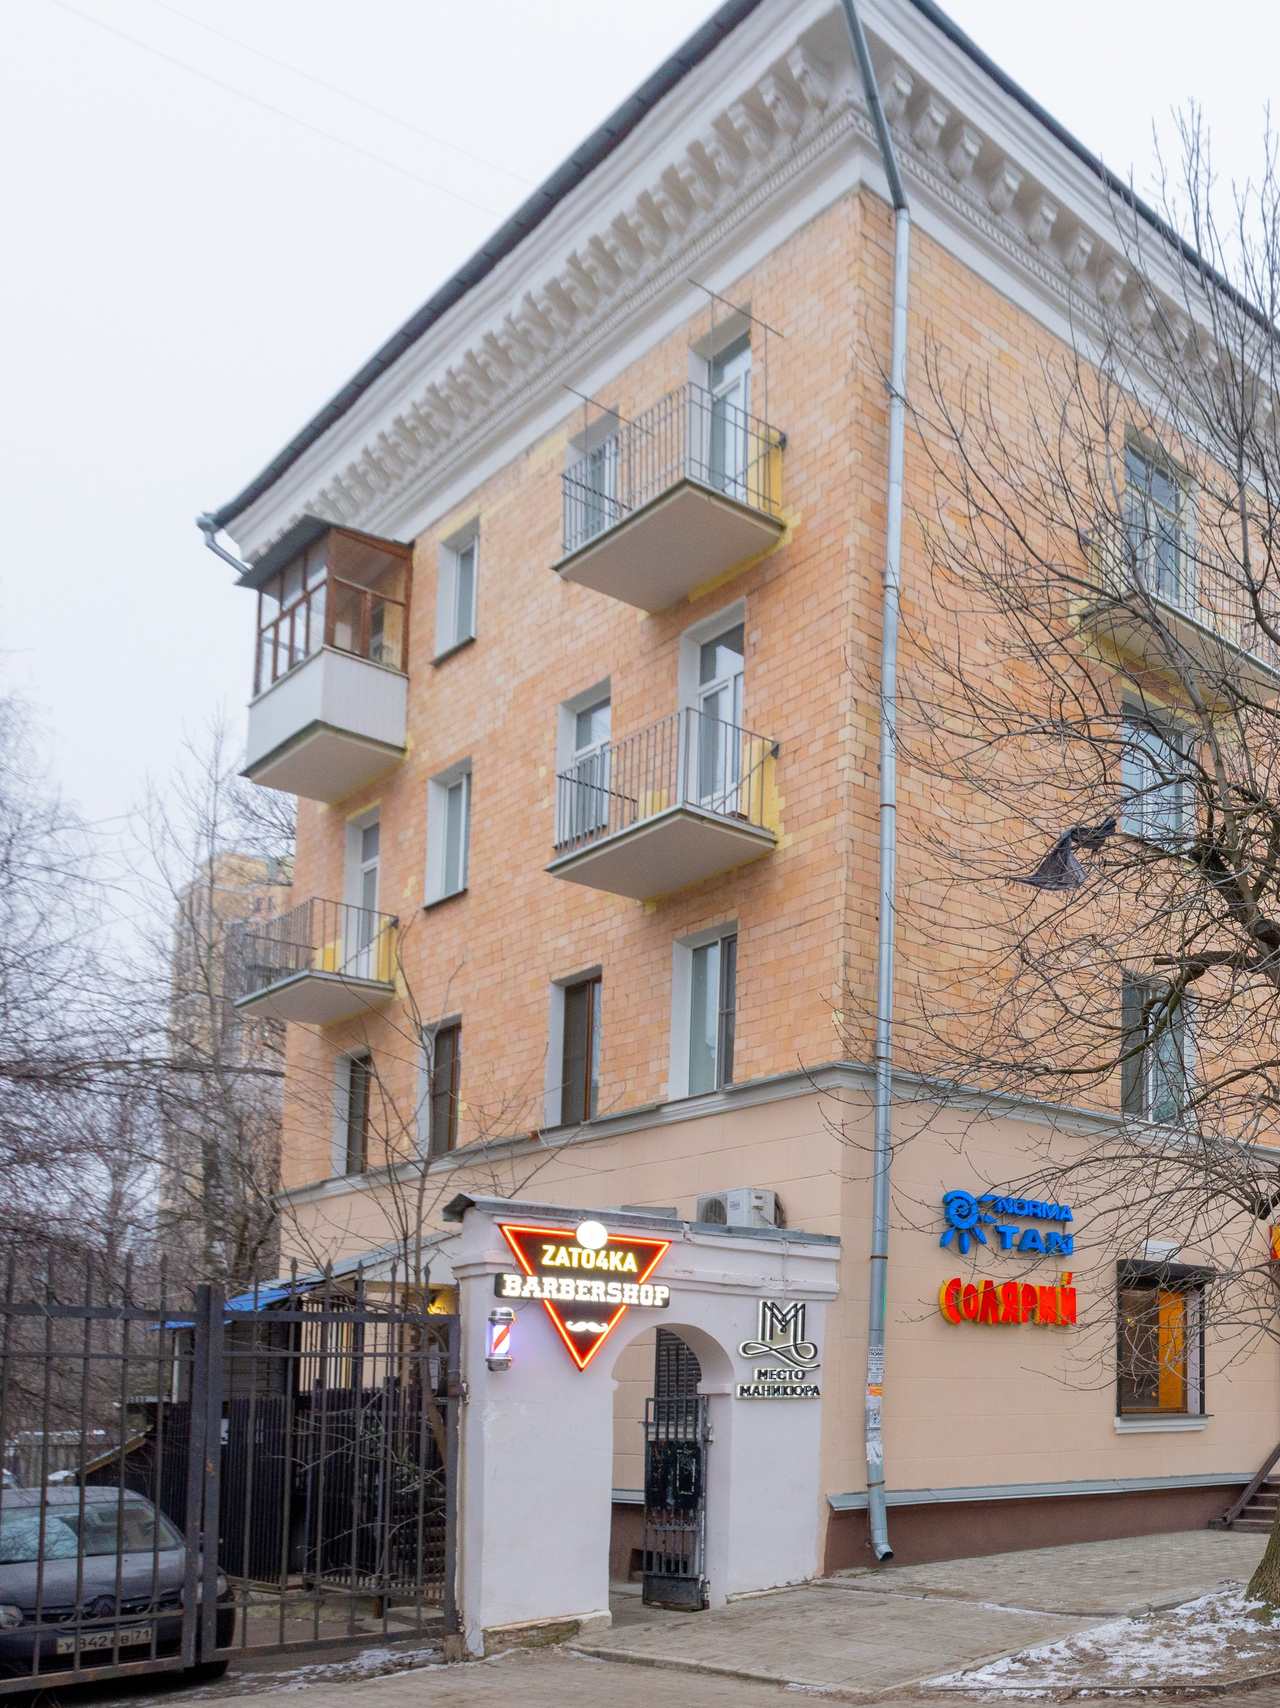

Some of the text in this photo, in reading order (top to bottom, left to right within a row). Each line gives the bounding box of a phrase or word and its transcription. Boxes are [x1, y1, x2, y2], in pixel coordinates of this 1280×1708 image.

[994, 1196, 1073, 1221] NORMA
[994, 1225, 1073, 1256] TAN
[541, 1244, 638, 1273] ZATO4KA
[501, 1274, 670, 1306] BARBERSHOP
[756, 1369, 806, 1380] МЕСТО
[738, 1385, 820, 1397] МАНИКЮРА
